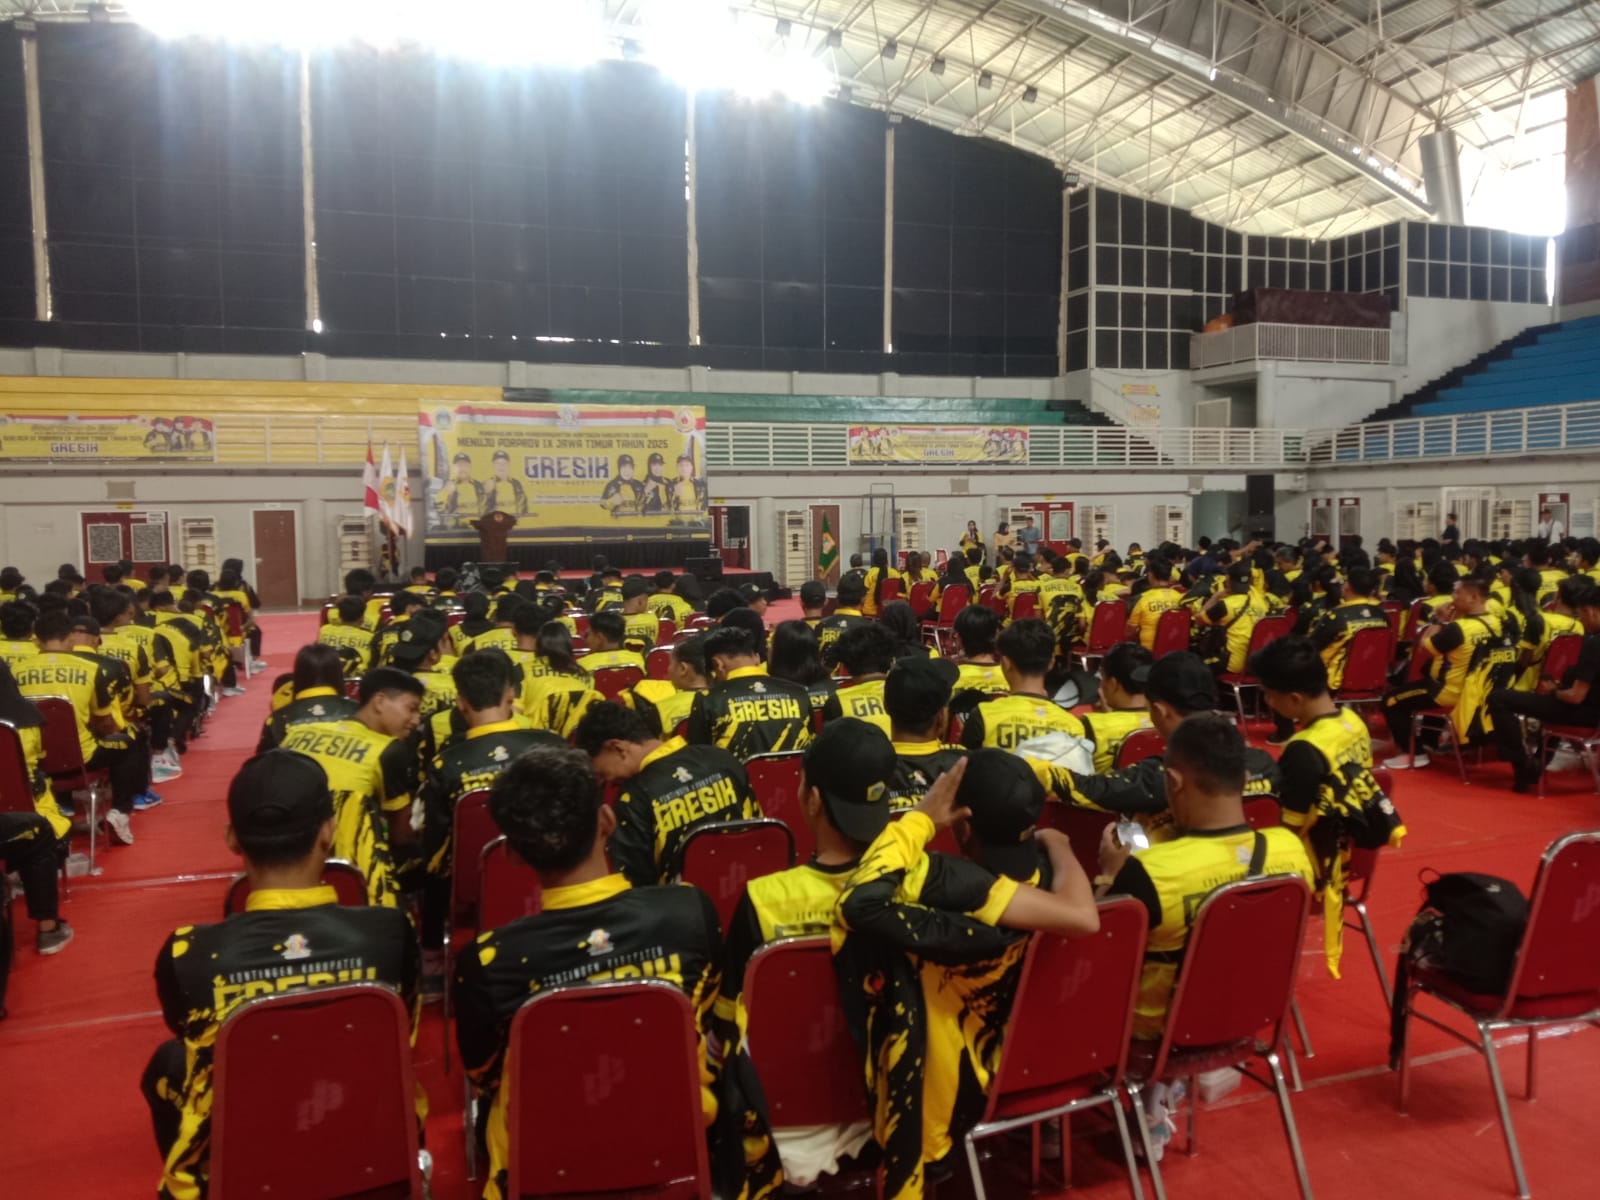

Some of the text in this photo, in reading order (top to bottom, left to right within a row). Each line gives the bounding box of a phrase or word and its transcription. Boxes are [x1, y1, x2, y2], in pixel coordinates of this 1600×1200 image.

[556, 439, 583, 449] JAWA
[586, 439, 614, 449] TIMUR
[616, 439, 646, 449] TAHUN
[647, 439, 669, 449] 2025
[524, 456, 609, 478] GRESIK
[16, 667, 88, 687] GRESIK
[730, 699, 800, 722] GRESIK
[652, 776, 738, 833] GRESIK
[229, 957, 363, 984] KONTINGEN KABUPATEN
